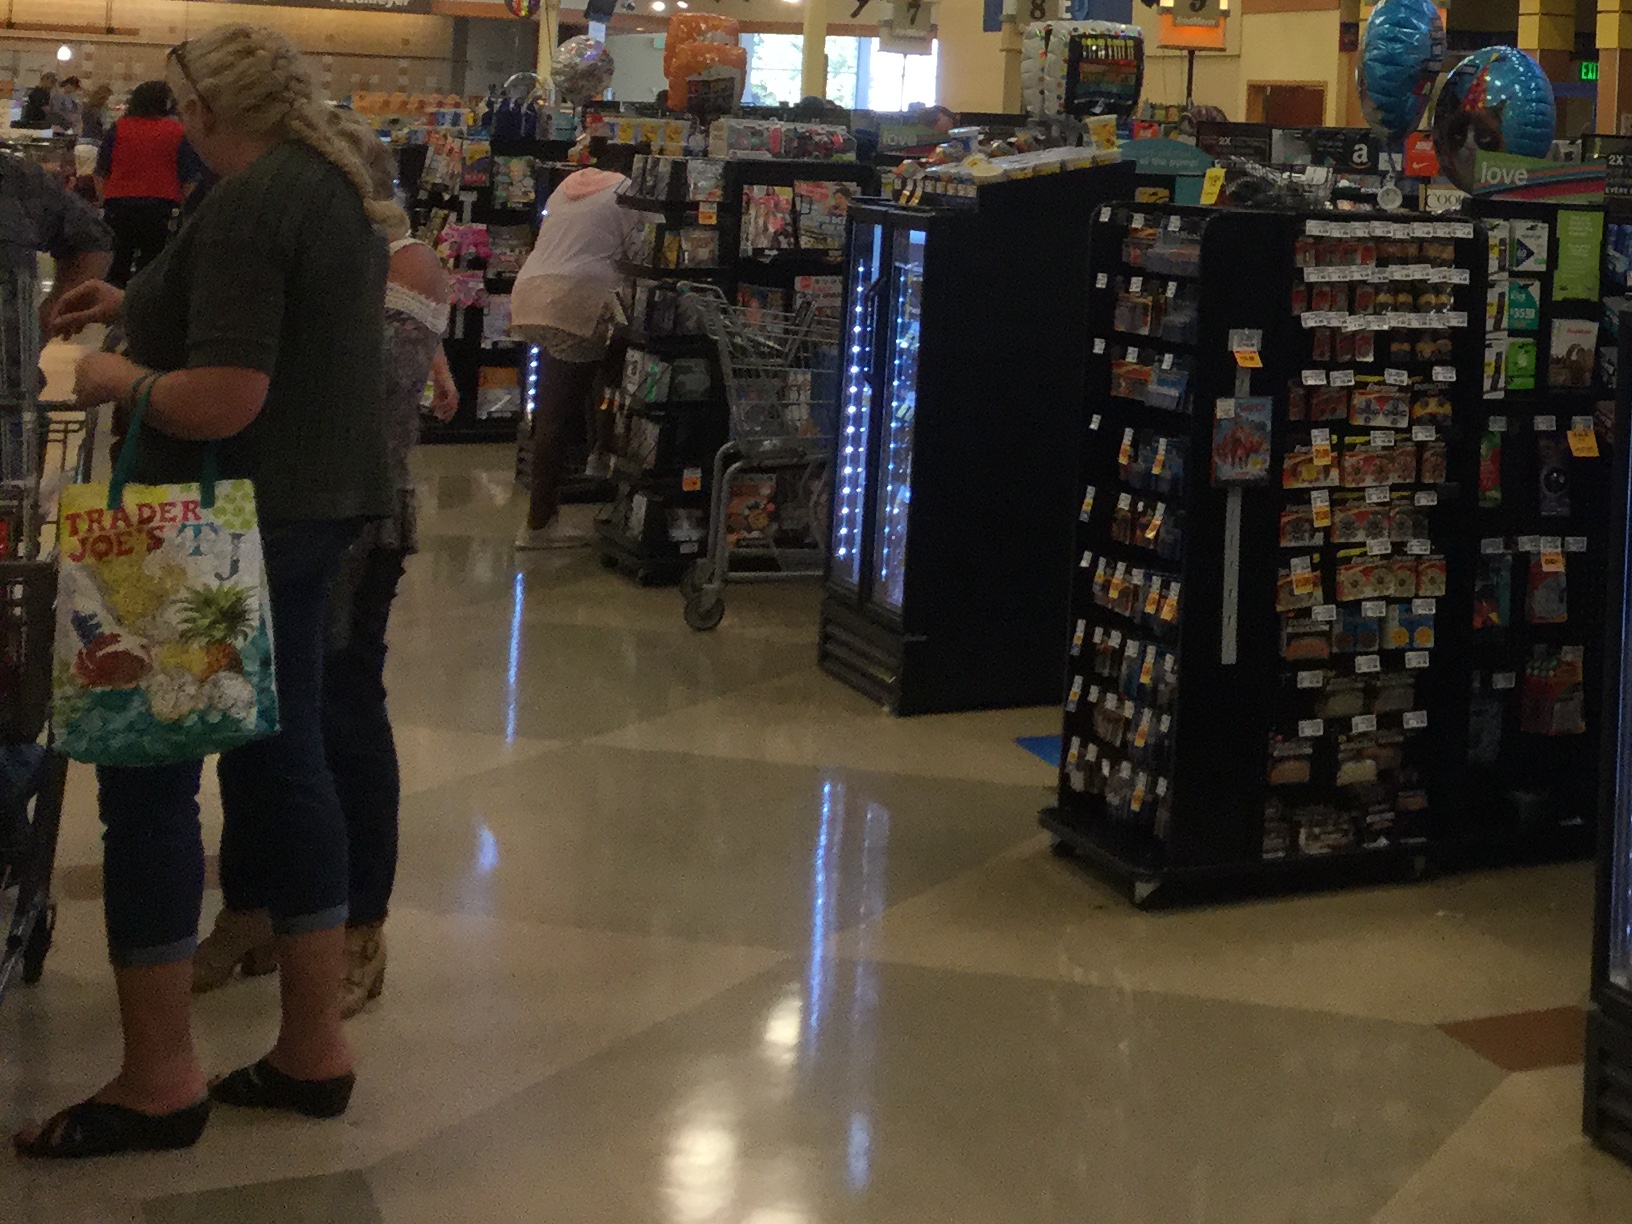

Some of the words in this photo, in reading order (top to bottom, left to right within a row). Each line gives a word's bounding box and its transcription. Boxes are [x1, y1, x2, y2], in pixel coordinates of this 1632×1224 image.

[906, 1, 921, 26] 7
[1479, 160, 1529, 185] love
[1608, 154, 1624, 166] 2X
[65, 499, 202, 538] TRADER
[68, 524, 166, 563] JOE'S
